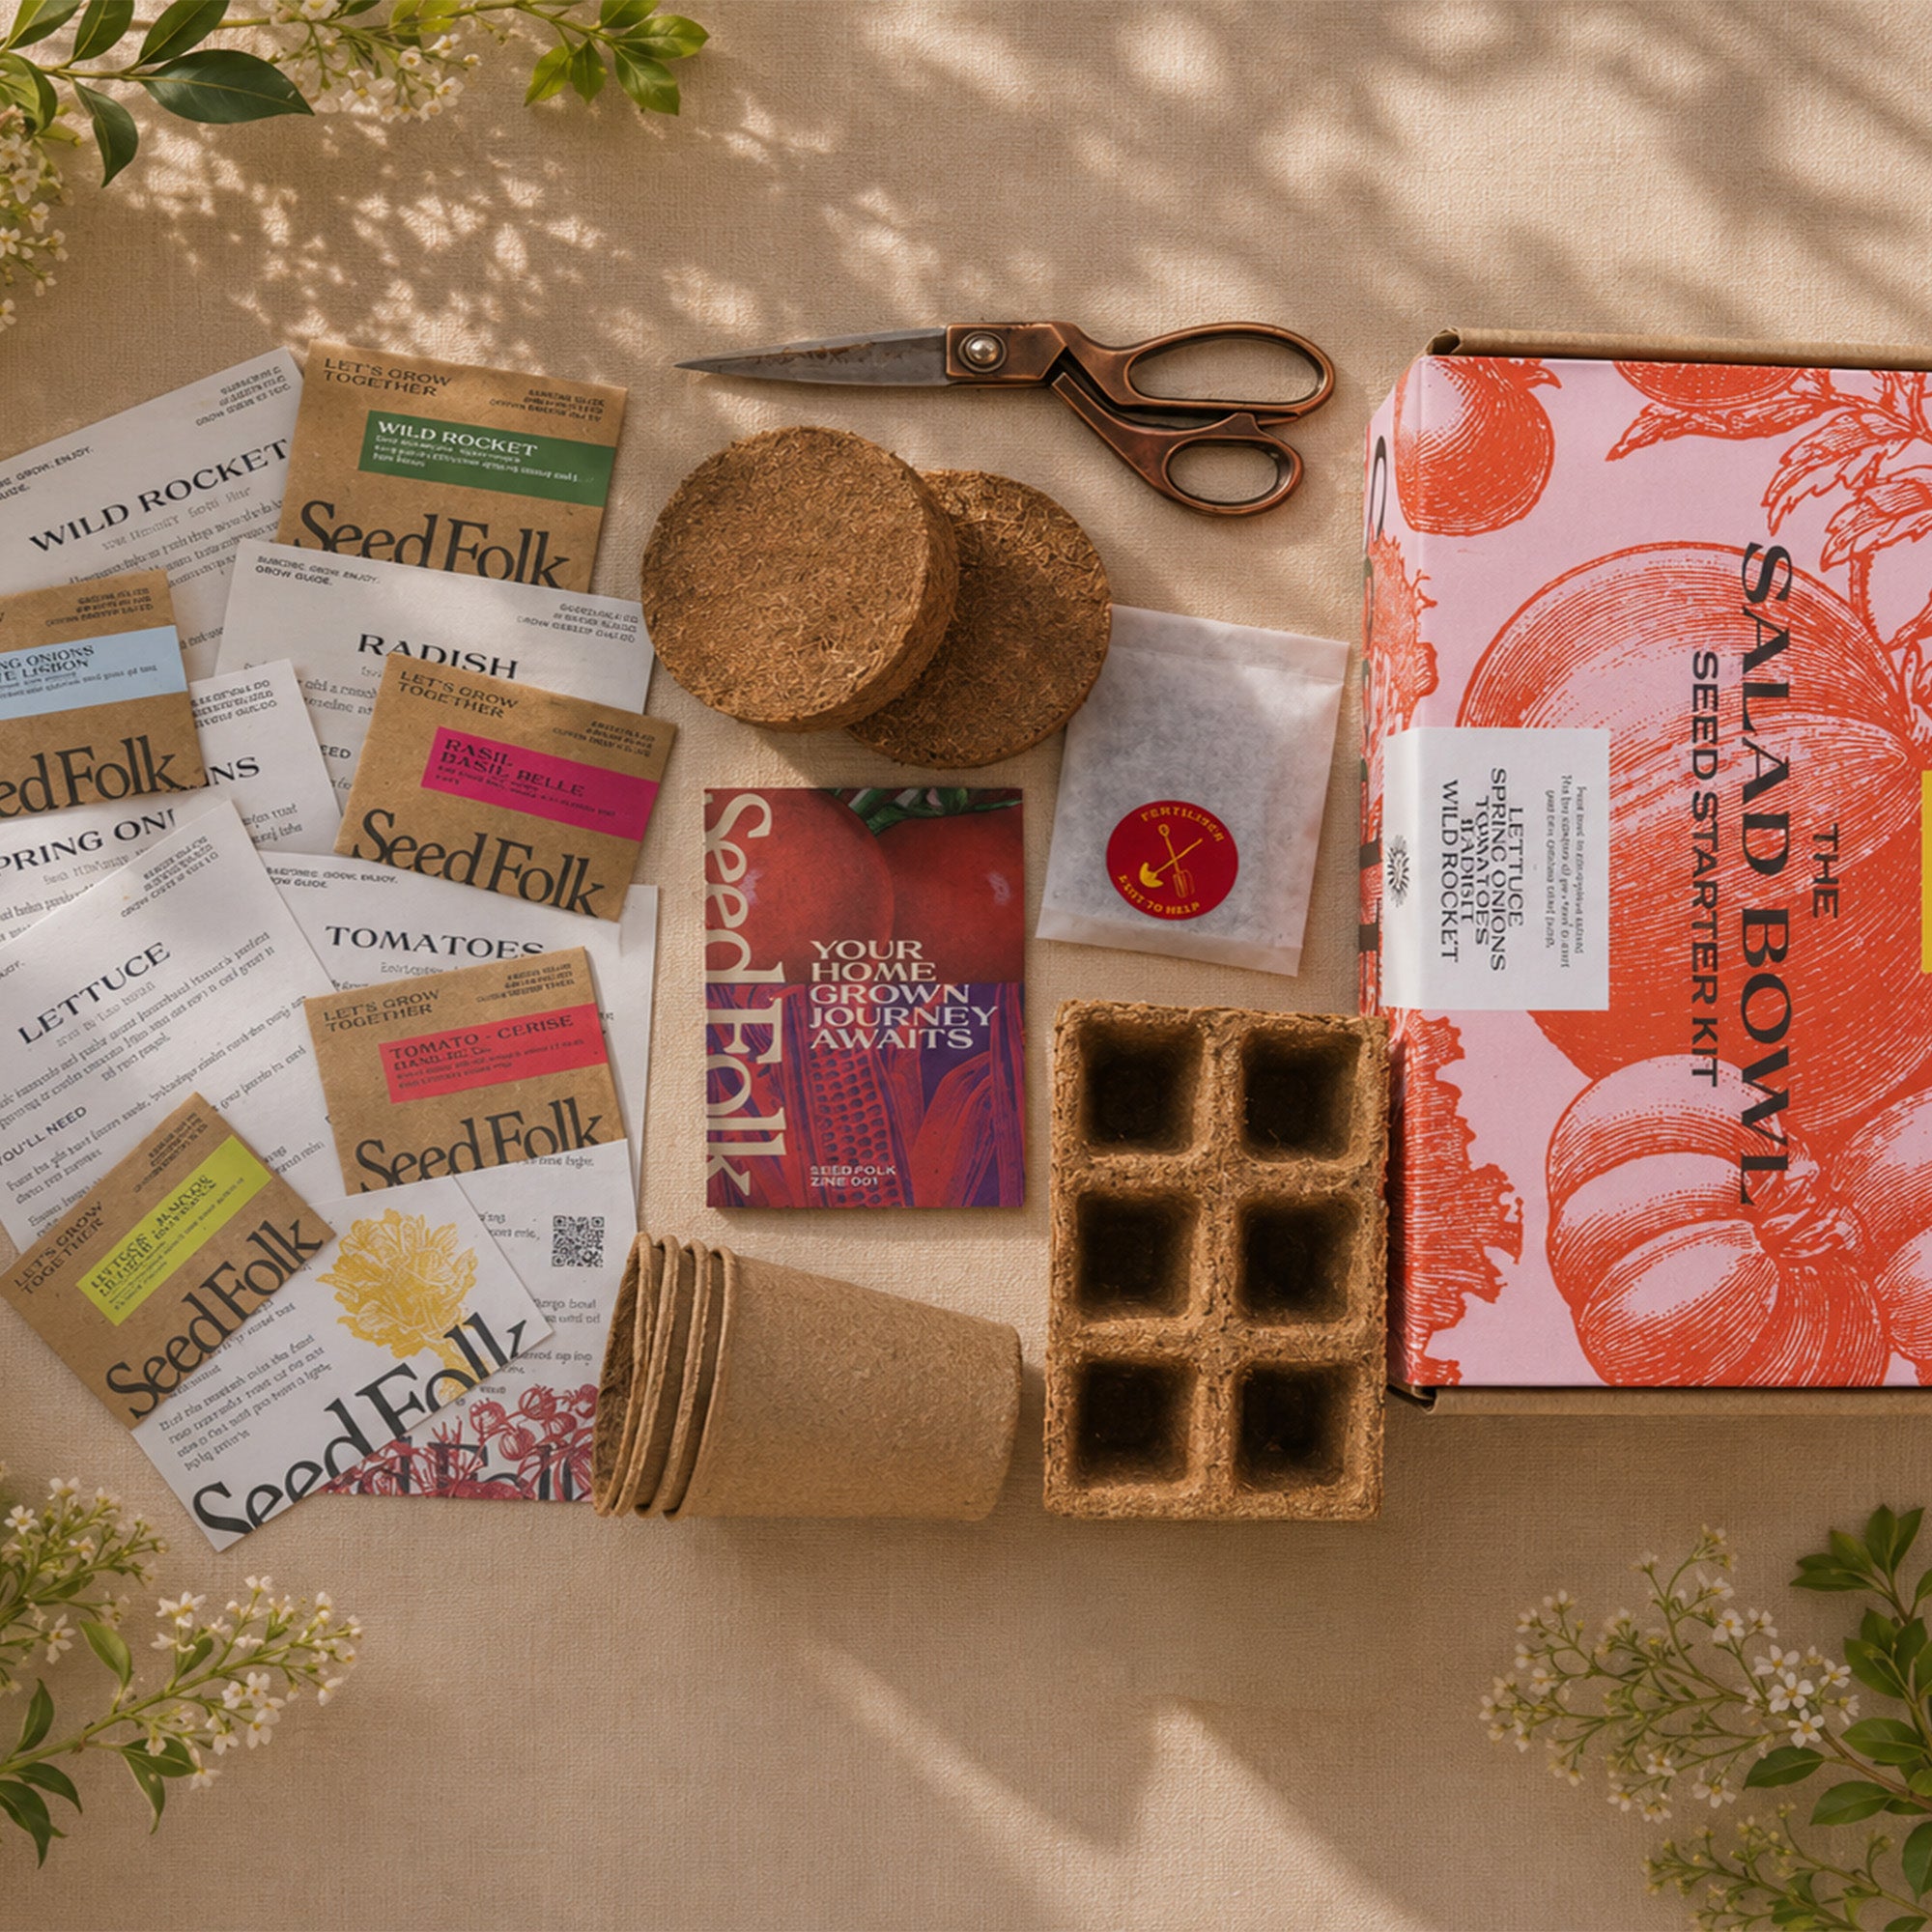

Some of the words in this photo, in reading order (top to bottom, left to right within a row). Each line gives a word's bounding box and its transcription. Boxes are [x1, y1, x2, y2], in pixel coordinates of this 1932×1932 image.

[323, 370, 438, 397] TOGETHER
[324, 357, 384, 377] LET'S
[388, 368, 452, 387] GROW
[378, 421, 437, 440] WILD
[441, 431, 538, 458] ROCKET
[29, 504, 129, 552] WILD
[137, 440, 288, 513] ROCKET
[357, 634, 519, 679] RADISH
[397, 681, 504, 719] TOGETHER
[400, 670, 454, 694] LET'S
[461, 687, 519, 709] GROW
[1691, 651, 1719, 780] SEED
[1741, 542, 1793, 877] SALAD
[320, 745, 352, 759] EED
[1440, 779, 1459, 846] WILD
[1507, 808, 1524, 927] LETTUCE
[1812, 823, 1839, 920] THE
[1440, 851, 1459, 963] ROCKET
[1691, 790, 1719, 1005] STARTER
[1491, 868, 1507, 972] ONIONS
[325, 925, 545, 959] TOMATOES
[810, 940, 923, 960] YOUR
[810, 961, 937, 982] HOME
[17, 942, 171, 1044] LETTUCE
[324, 1003, 377, 1022] LET'S
[383, 989, 440, 1008] GROW
[810, 983, 970, 1005] GROWN
[326, 1004, 433, 1033] TOGETHER
[810, 1006, 999, 1029] JOURNEY
[389, 1033, 479, 1061] TOMATO
[497, 1015, 574, 1040] CERISE
[810, 1028, 975, 1050] AWAITS
[1691, 1017, 1719, 1088] KIT
[1741, 907, 1794, 1208] BOWL
[45, 1106, 88, 1135] NEED
